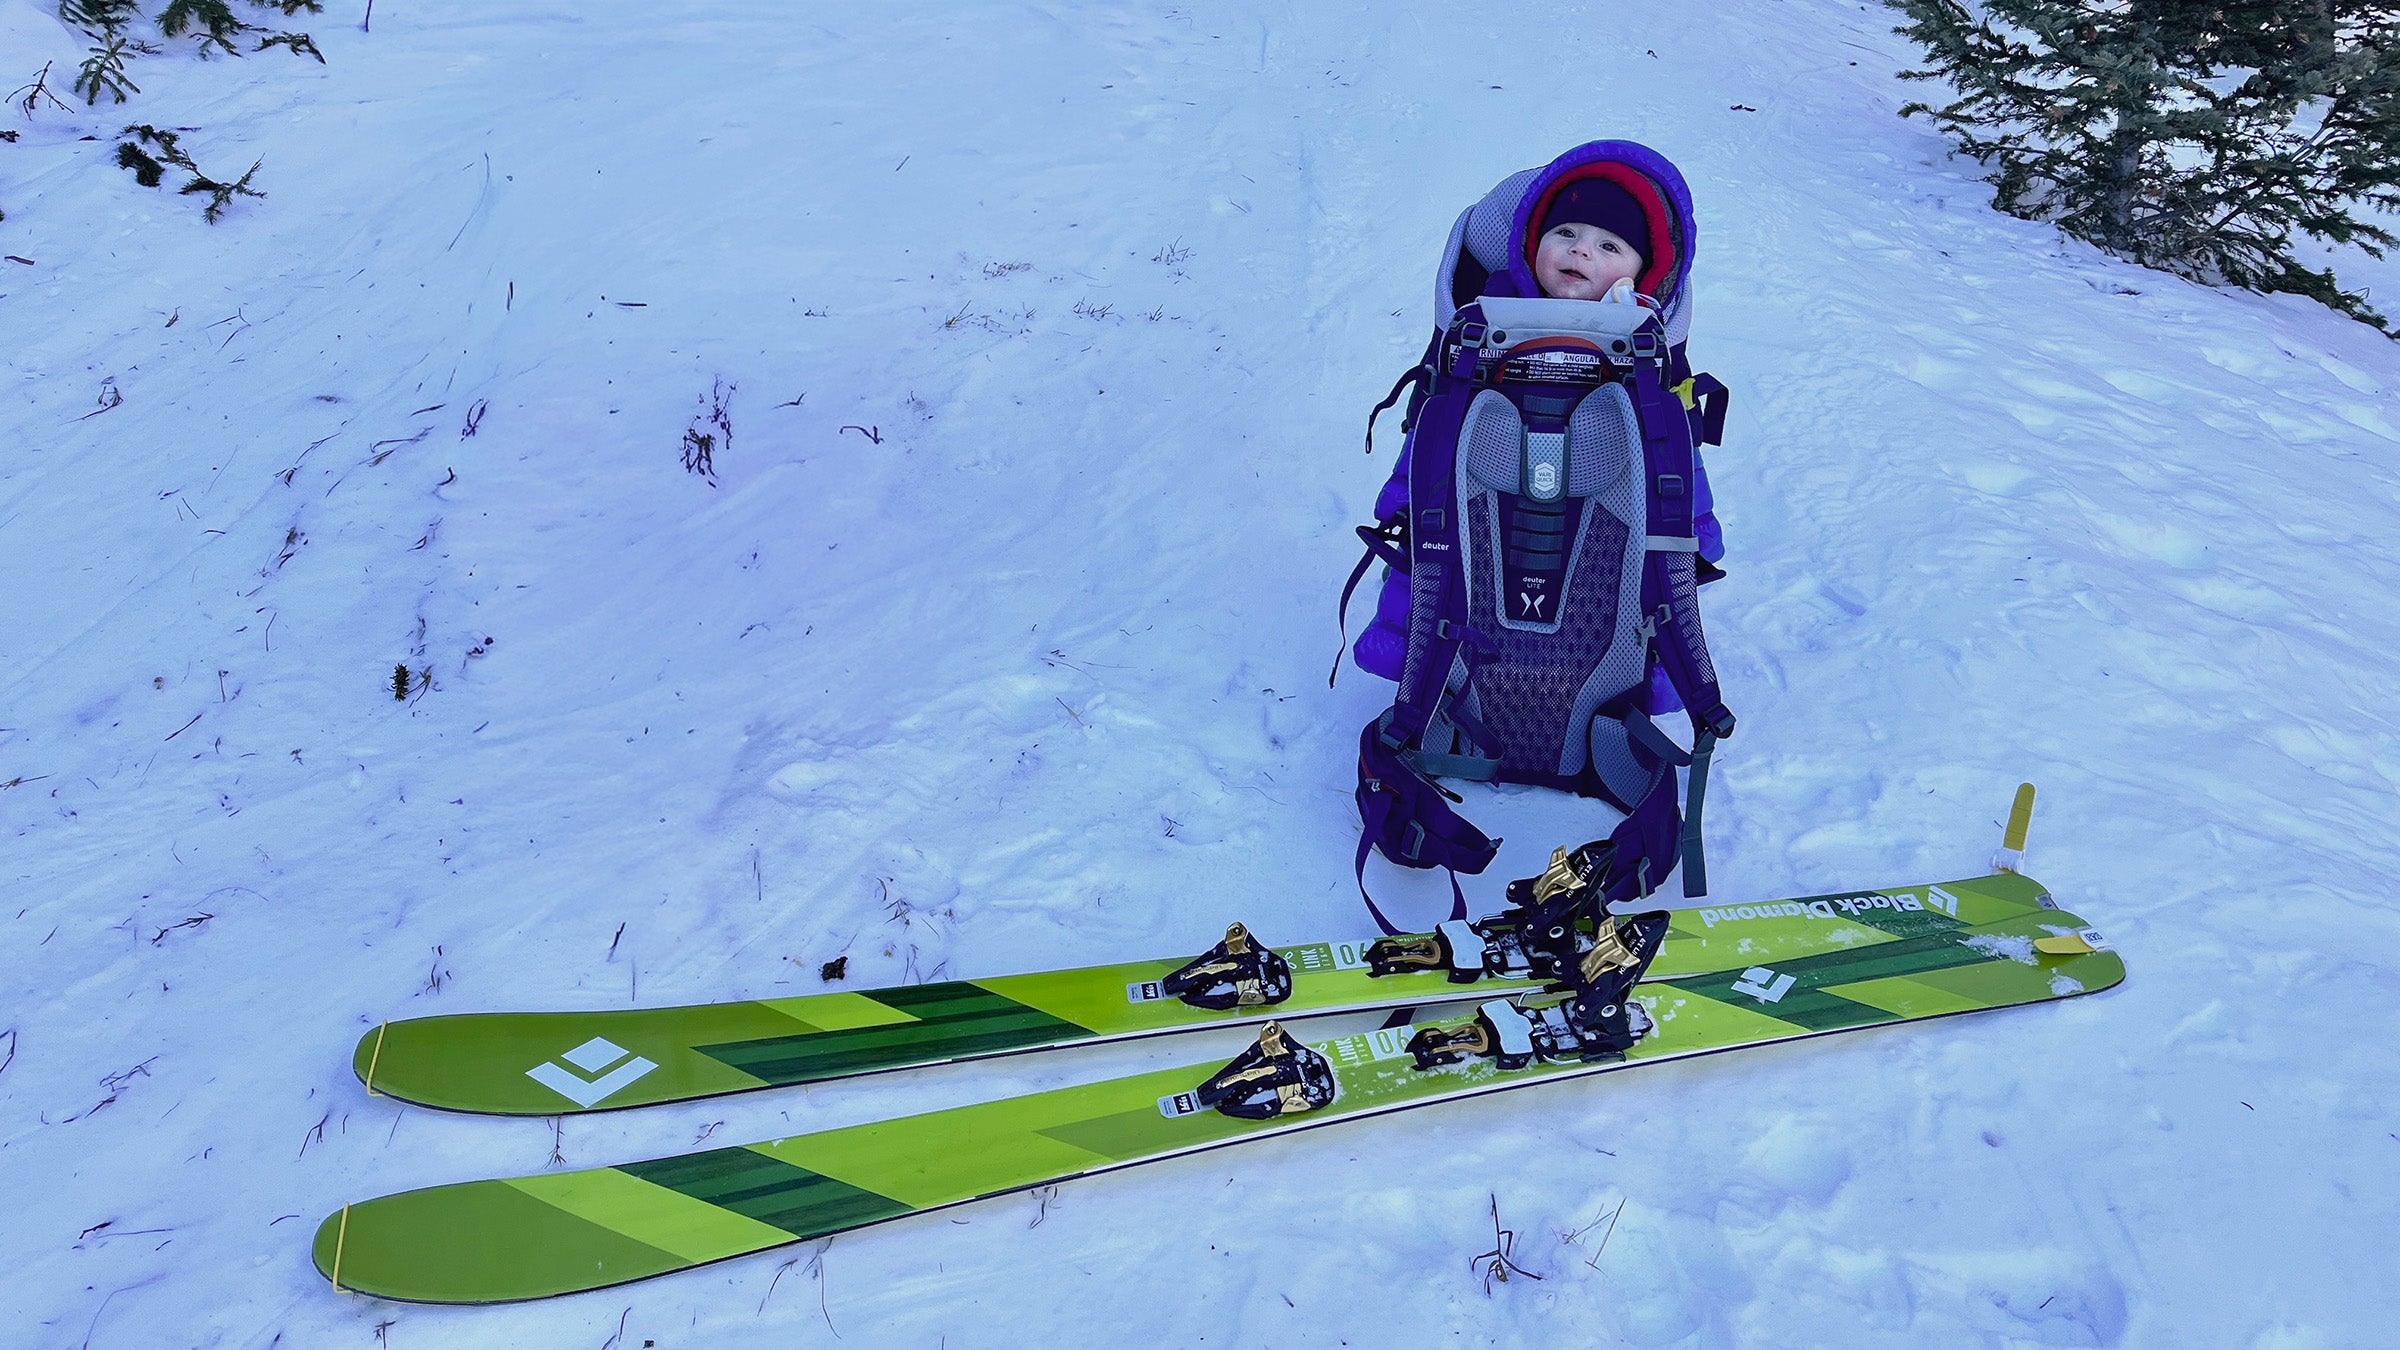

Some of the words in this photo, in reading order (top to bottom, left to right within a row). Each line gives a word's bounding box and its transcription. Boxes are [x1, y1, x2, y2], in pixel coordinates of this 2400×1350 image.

[1613, 357, 1634, 365] HAZA
[1422, 541, 1449, 551] deuter
[1522, 576, 1546, 584] deuter
[1700, 899, 1837, 928] Diamond
[1835, 893, 1925, 916] Black
[1300, 948, 1321, 969] LINK
[1334, 1038, 1358, 1062] LINK
